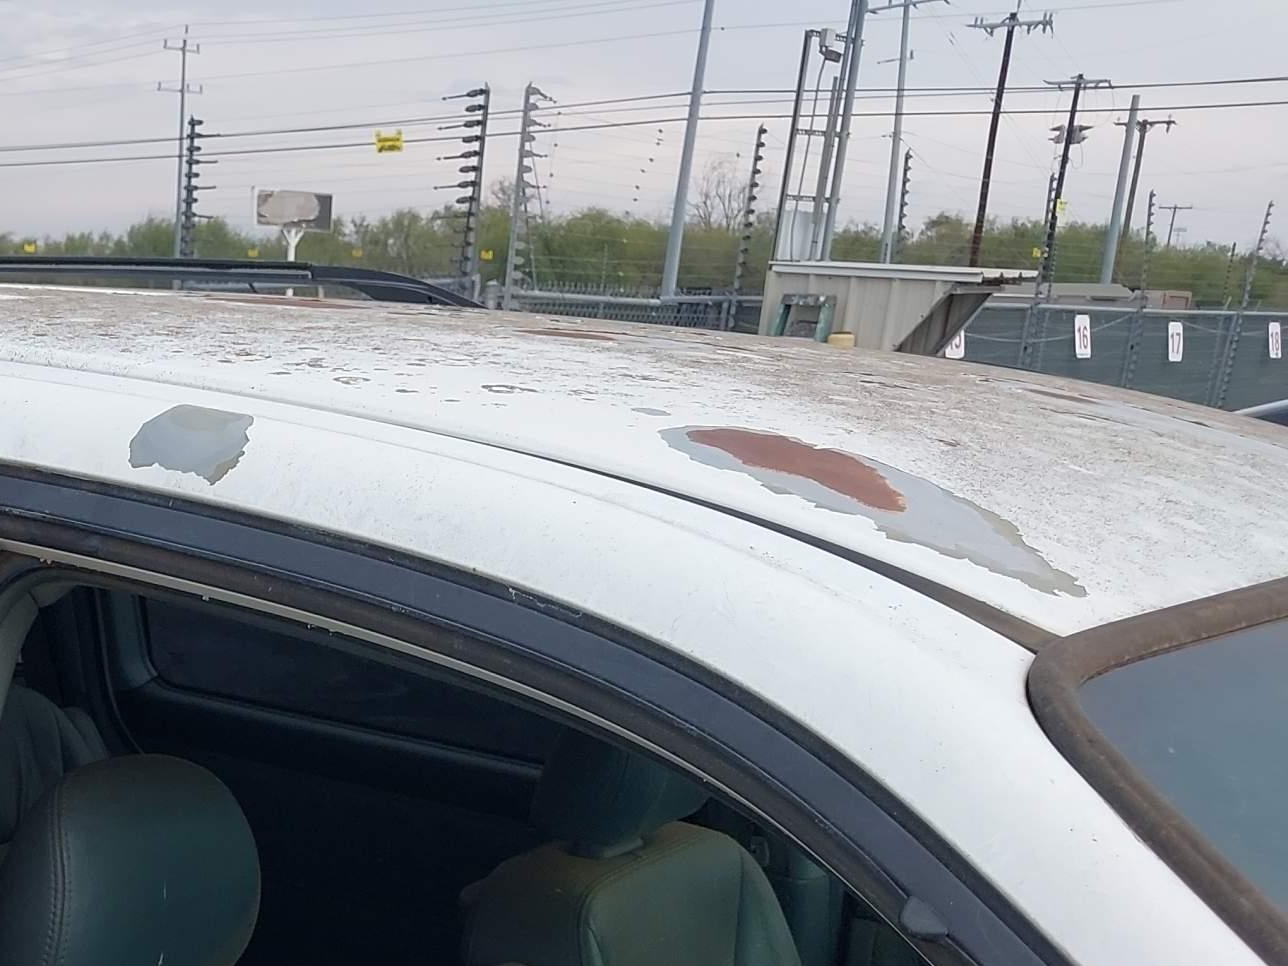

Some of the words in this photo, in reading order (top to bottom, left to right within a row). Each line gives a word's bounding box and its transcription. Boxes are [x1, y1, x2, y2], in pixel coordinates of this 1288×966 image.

[1077, 325, 1088, 350] 16
[1170, 332, 1181, 355] 17
[1270, 331, 1280, 352] 18
